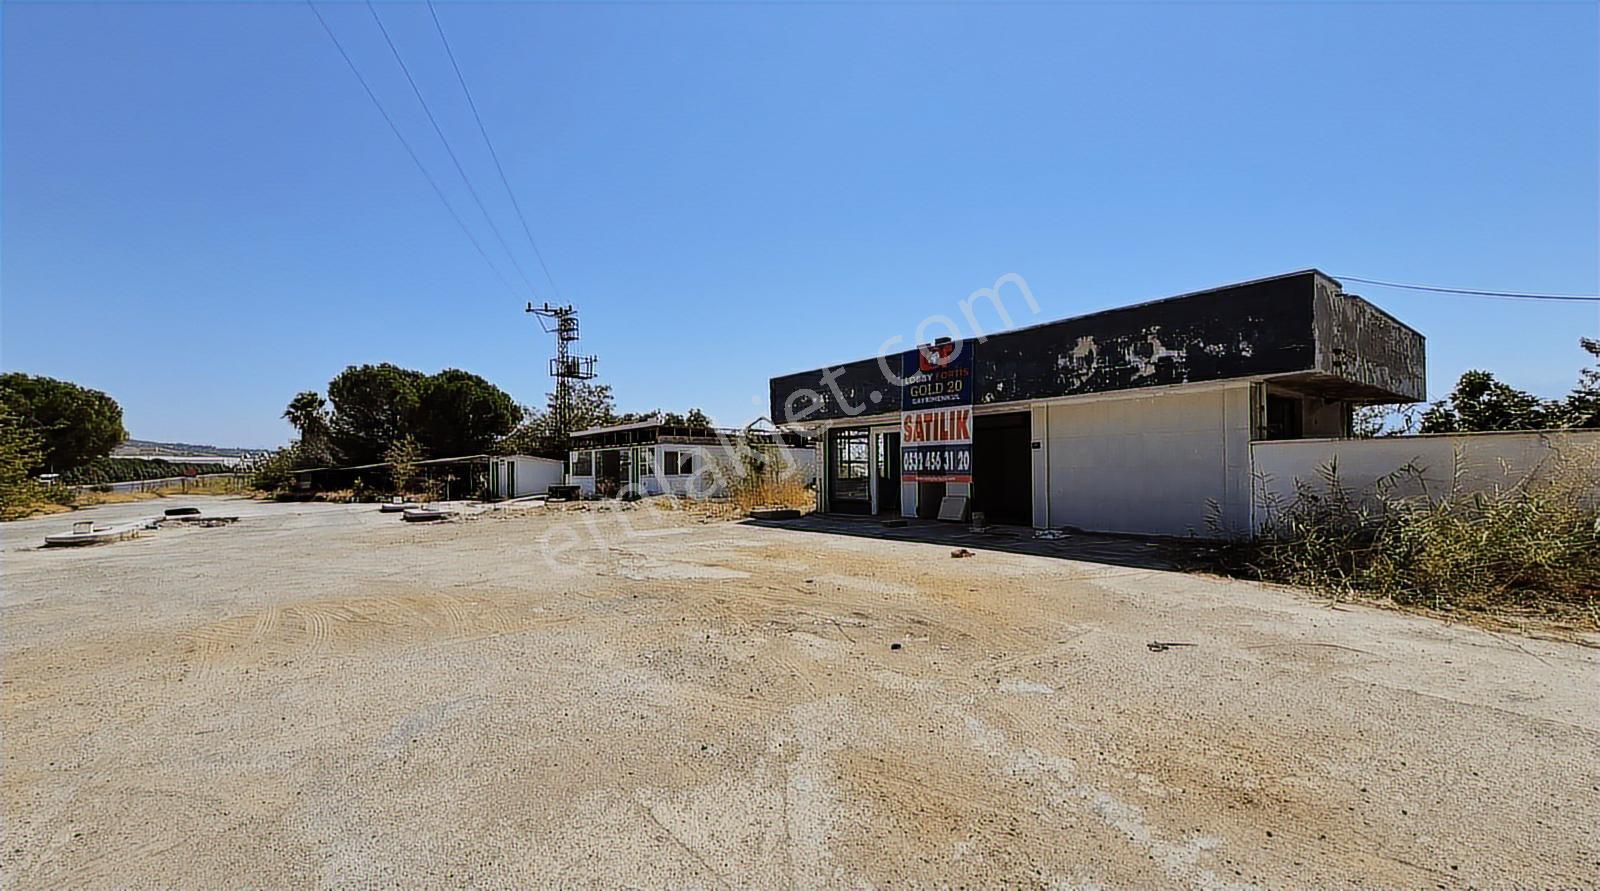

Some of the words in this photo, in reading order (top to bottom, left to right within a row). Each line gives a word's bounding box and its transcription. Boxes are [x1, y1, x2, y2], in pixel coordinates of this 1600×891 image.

[904, 373, 933, 385] LOBBY
[910, 382, 944, 397] GOLD
[947, 380, 963, 393] 20
[903, 409, 971, 443] SATILIK
[903, 452, 924, 471] 0532
[925, 451, 942, 471] 456
[943, 450, 954, 471] 31
[957, 450, 970, 471] 20
